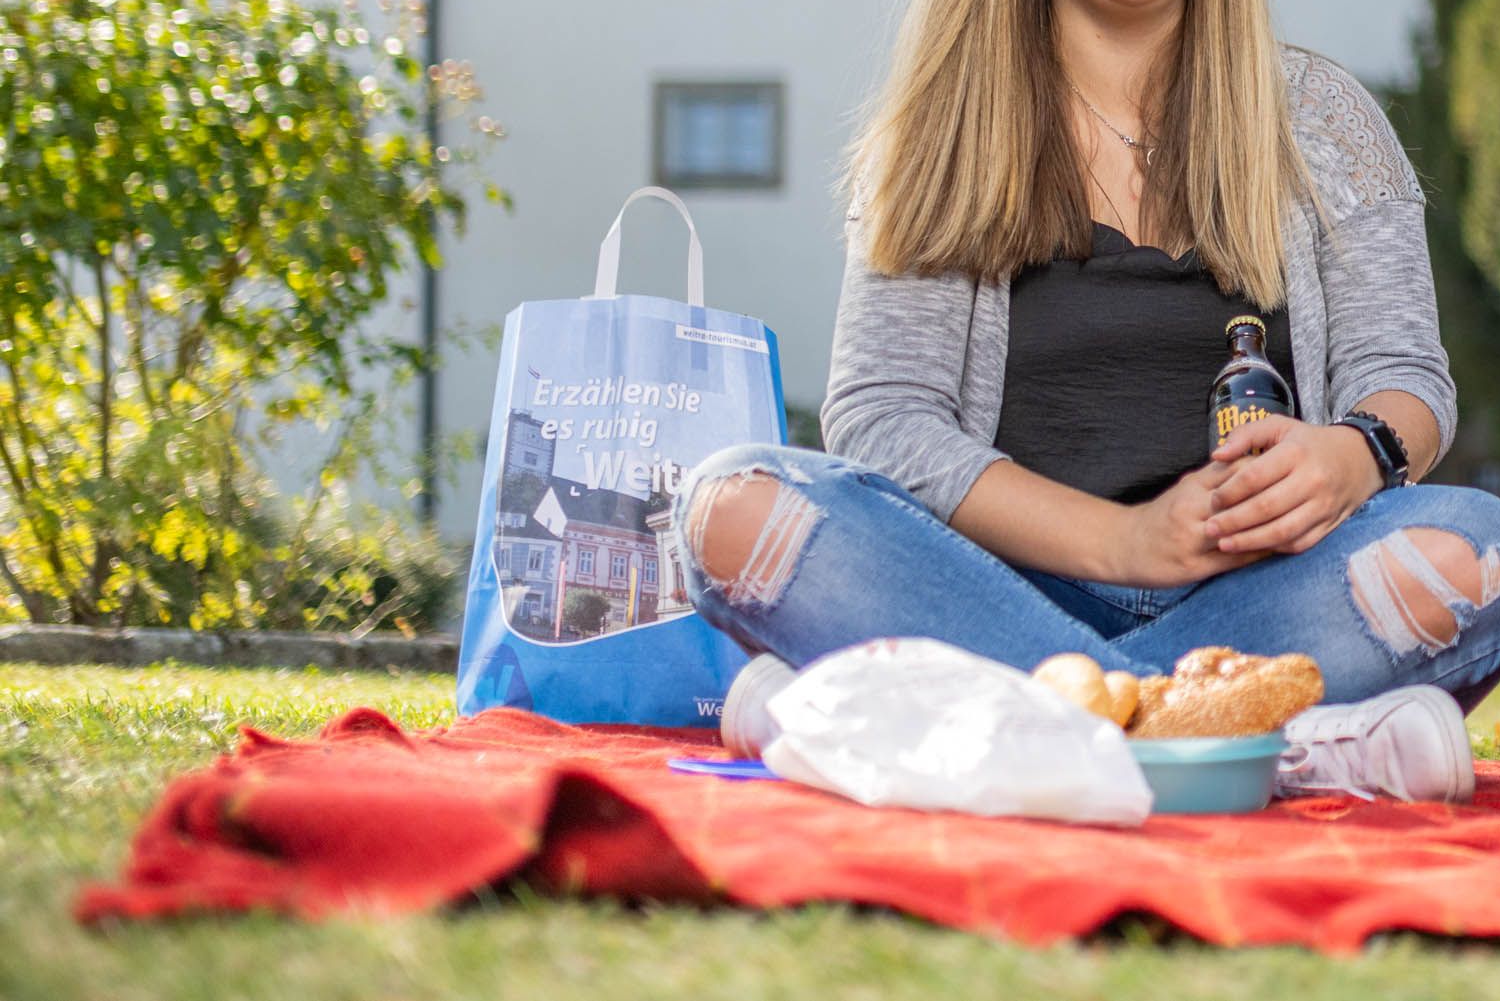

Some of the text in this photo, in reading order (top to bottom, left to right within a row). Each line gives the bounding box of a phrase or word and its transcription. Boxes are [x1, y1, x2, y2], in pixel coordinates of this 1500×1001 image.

[532, 375, 701, 413] Erzählen Sie
[541, 410, 659, 448] es ruhig
[1216, 404, 1272, 436] Weit
[697, 702, 724, 717] We
